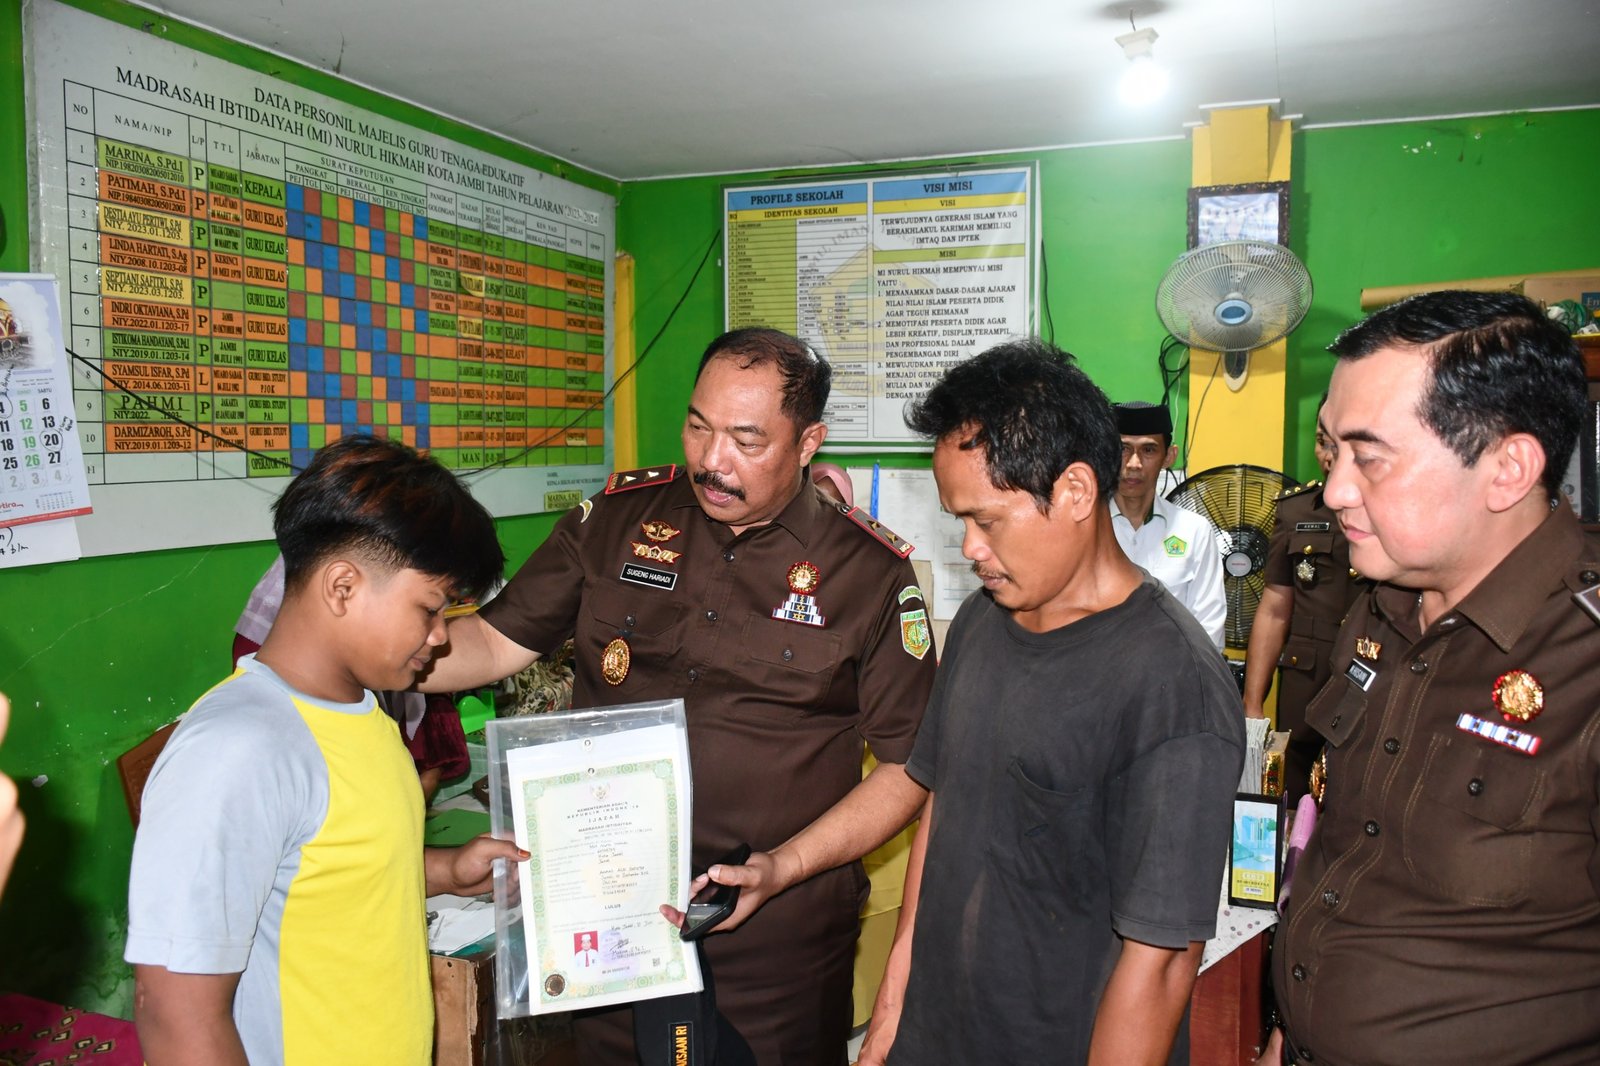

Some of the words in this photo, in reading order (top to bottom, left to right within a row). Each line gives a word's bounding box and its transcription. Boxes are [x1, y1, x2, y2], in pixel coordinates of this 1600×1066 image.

[73, 103, 88, 115] NO
[116, 66, 215, 110] MADRASAH
[220, 98, 304, 137] IBTIDAIYAH
[307, 123, 332, 147] (MI)
[335, 134, 377, 159] NURUL
[379, 148, 425, 174] HIKMAH
[427, 163, 454, 184] KOTA
[456, 173, 485, 192] JAMBI
[486, 181, 517, 203] TAHUN
[518, 192, 564, 216] PELAJARAN
[191, 135, 205, 146] L/P
[254, 87, 291, 113] DATA
[294, 100, 356, 133] PERSONIL
[359, 121, 406, 150] MAJELIS
[408, 139, 438, 160] GURU
[440, 150, 480, 174] TENAGA
[482, 163, 525, 187] EDUKATIF
[105, 143, 155, 168] MARINA,
[157, 156, 183, 172] S.Pd.I
[246, 150, 280, 166] JABATAN
[194, 166, 204, 180] P
[295, 164, 328, 179] PANGKAT
[321, 156, 349, 171] SURAT
[349, 165, 394, 185] KEPUTUSAN
[80, 177, 86, 186] 2
[107, 174, 159, 197] PATIMAH,
[160, 186, 186, 201] S.Pd.I
[304, 177, 319, 189] TGL
[324, 183, 335, 193] NO
[346, 176, 376, 193] BERKALA
[923, 183, 945, 193] VISI
[948, 181, 973, 192] MISI
[244, 180, 283, 201] KEPALA
[354, 190, 367, 202] TGL
[750, 193, 793, 205] PROFILE
[795, 190, 843, 202] SEKOLAH
[194, 196, 205, 211] P
[371, 195, 382, 204] NO
[940, 199, 956, 207] VISI
[81, 209, 87, 218] 3
[103, 206, 129, 223] DESTIA
[129, 211, 142, 224] AYU
[245, 208, 263, 224] GURU
[264, 211, 284, 228] KELAS
[764, 209, 802, 218] IDENTITAS
[803, 207, 838, 216] SEKOLAH
[881, 215, 933, 226] TERWUJUDNYA
[935, 213, 971, 223] GENERASI
[973, 212, 996, 220] ISLAM
[998, 210, 1018, 219] YANG
[196, 226, 206, 241] P
[886, 227, 938, 236] BERAKHLAKUL
[940, 224, 975, 233] KARIMAH
[976, 221, 1012, 230] MEMILIKI
[82, 242, 87, 251] 4
[245, 237, 264, 252] GURU
[264, 240, 285, 255] KELAS
[916, 236, 939, 245] IMTAQ
[941, 235, 956, 243] DAN
[958, 234, 980, 242] IPTEK
[109, 237, 135, 253] LINDA
[136, 242, 170, 259] HARTATI,
[171, 248, 187, 264] S.Ag
[939, 250, 957, 258] MISI
[195, 256, 206, 270] P
[83, 274, 88, 283] 5
[105, 270, 139, 286] SEPTIANI
[246, 265, 265, 279] GURU
[265, 268, 285, 283] KELAS
[887, 268, 910, 276] NURUL
[912, 267, 941, 275] HIKMAH
[877, 279, 898, 287] YAITU
[196, 285, 207, 299] P
[885, 288, 934, 297] MENANAMKAN
[987, 285, 1016, 293] AJARAN
[111, 301, 132, 314] INDRI
[246, 292, 265, 306] GURU
[265, 294, 286, 309] KELAS
[926, 298, 947, 306] ISLAM
[949, 297, 981, 305] PESERTA
[83, 306, 90, 315] 6
[885, 310, 904, 318] AGAR
[906, 309, 930, 317] TEGUH
[931, 308, 969, 316] KEIMANAN
[197, 314, 208, 328] P
[247, 320, 265, 334] GURU
[266, 321, 286, 336] KELAS
[885, 320, 929, 328] MEMOTIFASI
[964, 318, 985, 326] DIDIK
[987, 317, 1007, 325] AGAR
[885, 330, 906, 338] LEBIH
[85, 338, 90, 347] 7
[885, 340, 899, 348] DAN
[901, 339, 950, 348] PROFESIONAL
[198, 343, 209, 357] P
[247, 349, 266, 362] GURU
[266, 350, 287, 363] KELAS
[885, 350, 942, 358] PENGEMBANGAN
[885, 361, 934, 369] MEWUJUDKAN
[86, 370, 91, 380] 8
[111, 364, 149, 377] SYAMSUL
[150, 366, 175, 381] ISFAR,
[198, 372, 209, 386] L
[885, 371, 916, 379] MENJADI
[19, 400, 28, 412] 5
[42, 397, 50, 410] 6
[86, 403, 92, 411] 9
[199, 401, 210, 415] P
[20, 417, 33, 431] 12
[41, 415, 55, 429] 13
[85, 434, 96, 443] 10
[114, 426, 174, 440] DARMIZAROH,
[0, 438, 14, 451] 18
[22, 435, 36, 449] 19
[44, 433, 59, 446] 20
[3, 456, 18, 470] 25
[25, 453, 40, 467] 26
[48, 451, 61, 464] 27
[462, 452, 480, 464] MAN
[9, 475, 18, 488] 2
[31, 472, 40, 485] 3
[626, 568, 649, 578] SUGENG
[649, 573, 671, 584] HARIADI
[588, 813, 620, 823] IJAZAH
[675, 1025, 688, 1036] RI
